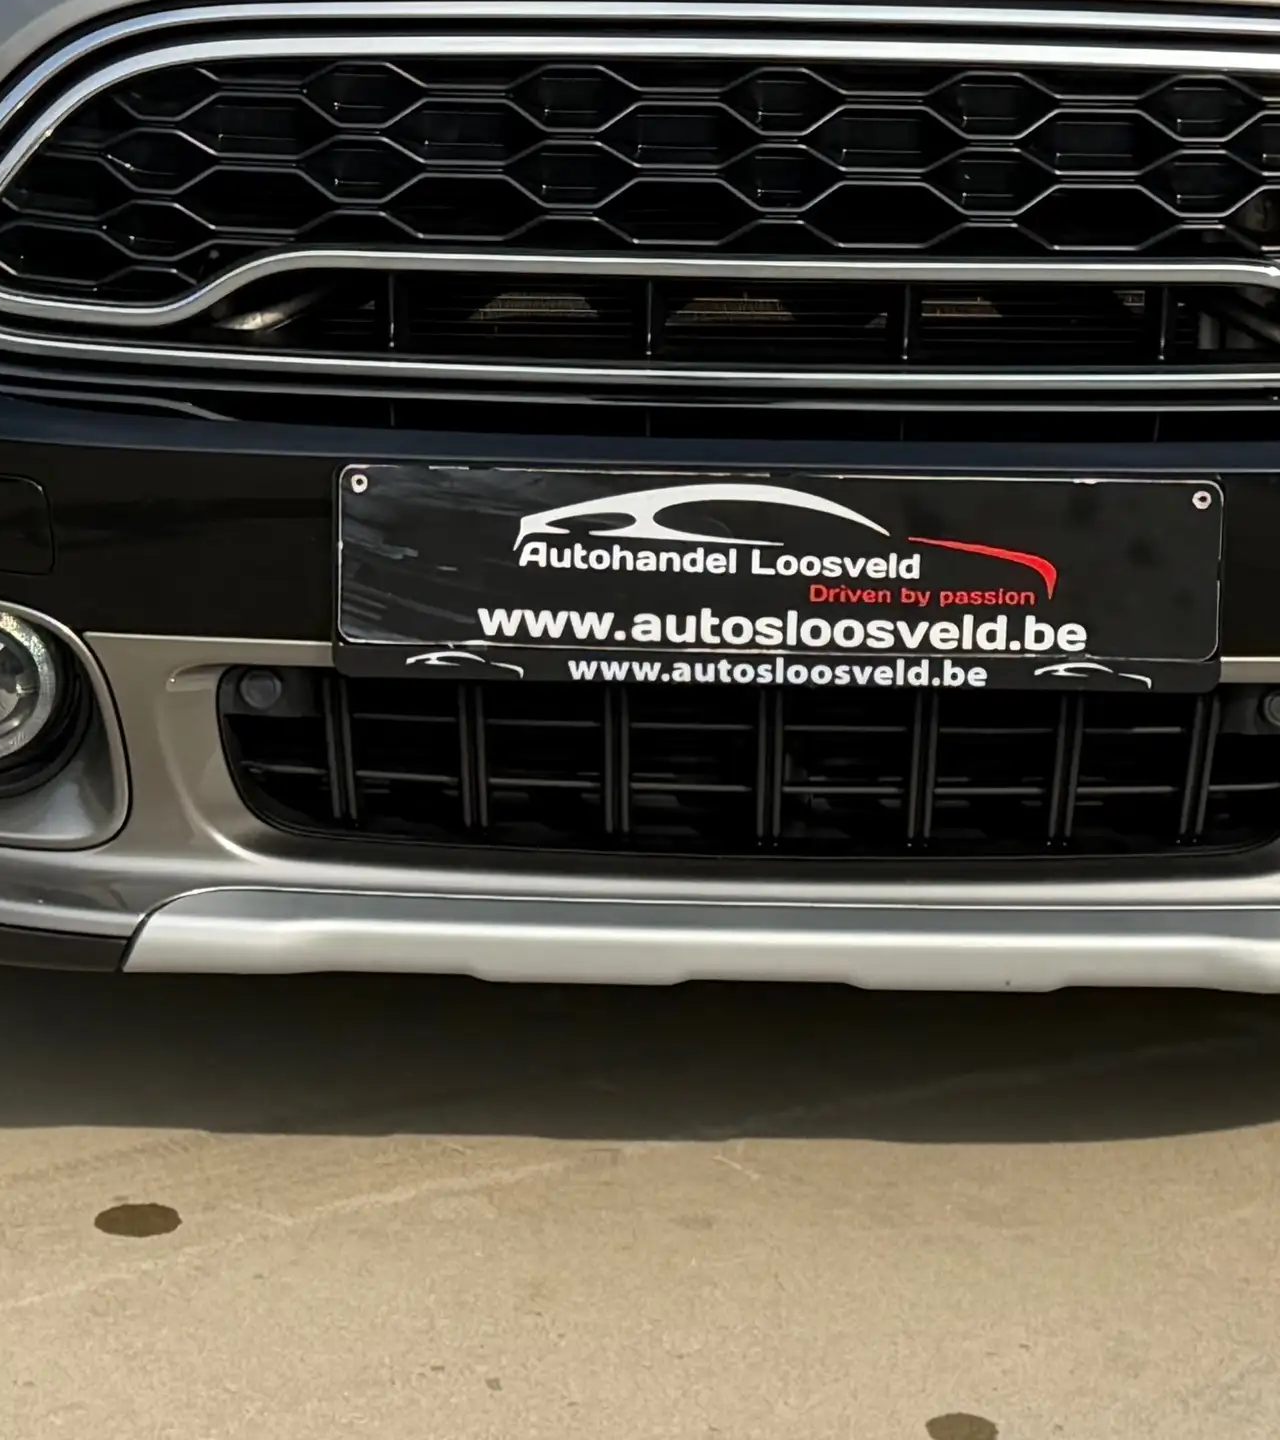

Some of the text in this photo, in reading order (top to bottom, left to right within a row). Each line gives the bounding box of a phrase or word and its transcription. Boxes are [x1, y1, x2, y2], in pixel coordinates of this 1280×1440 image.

[518, 541, 921, 580] Autohandel Loosveld
[809, 584, 1036, 608] Driven by passion
[477, 607, 1088, 652] www.autosloosveld.be
[567, 656, 988, 688] www.autosloosveld.be
